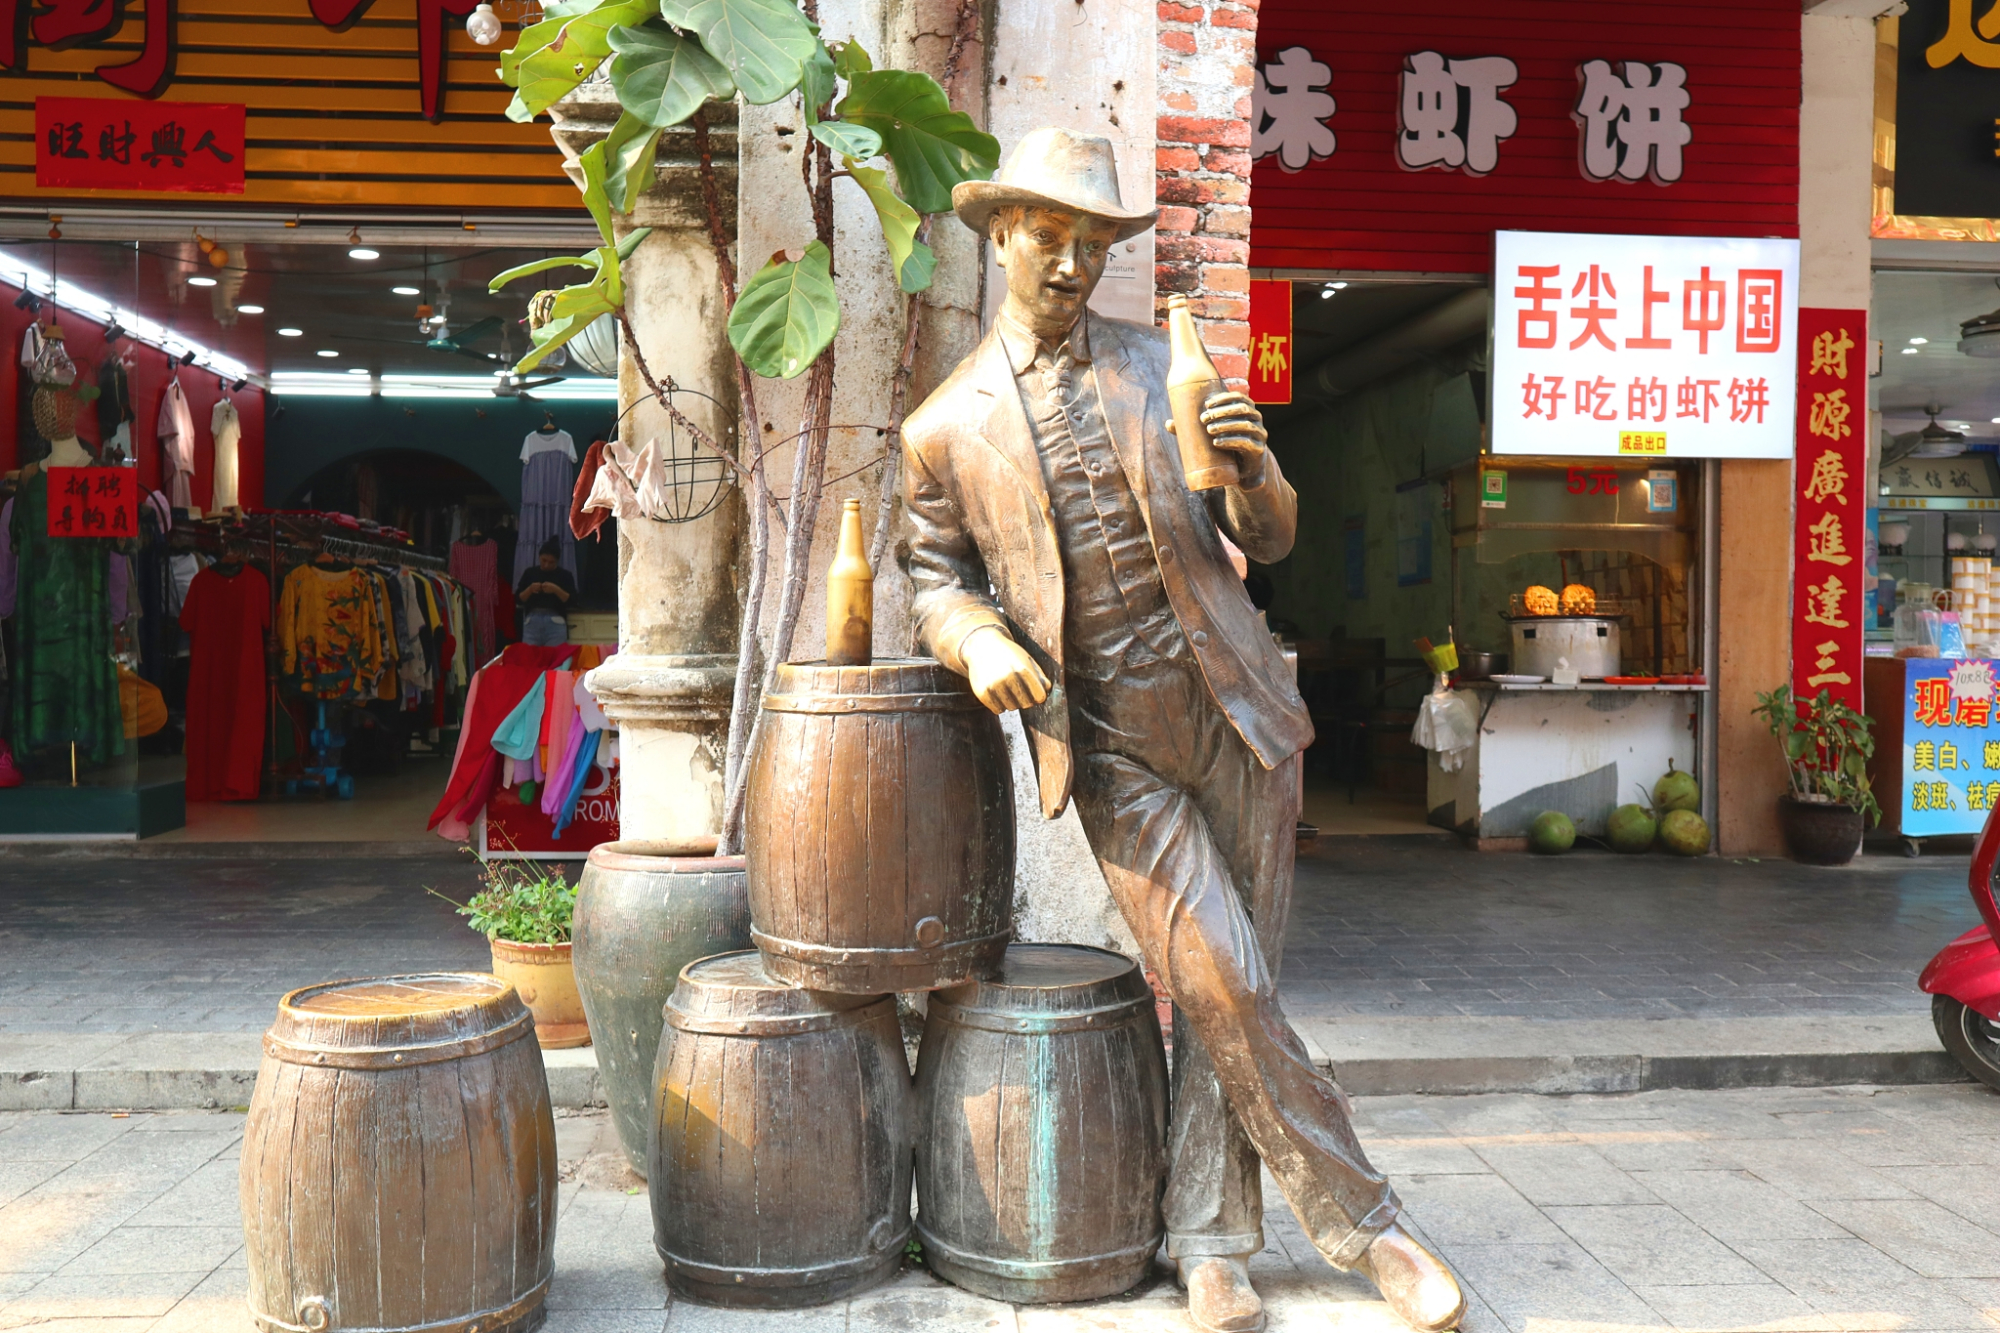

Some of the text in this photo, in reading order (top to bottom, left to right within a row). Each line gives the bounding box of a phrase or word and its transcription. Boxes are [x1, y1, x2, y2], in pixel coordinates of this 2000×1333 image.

[1514, 263, 1783, 355] 舌尖上中国
[1521, 372, 1770, 424] 好吃的虾饼
[1621, 434, 1666, 451] 成品出口
[1566, 466, 1620, 496] 5元
[1914, 677, 2000, 727] 现磨
